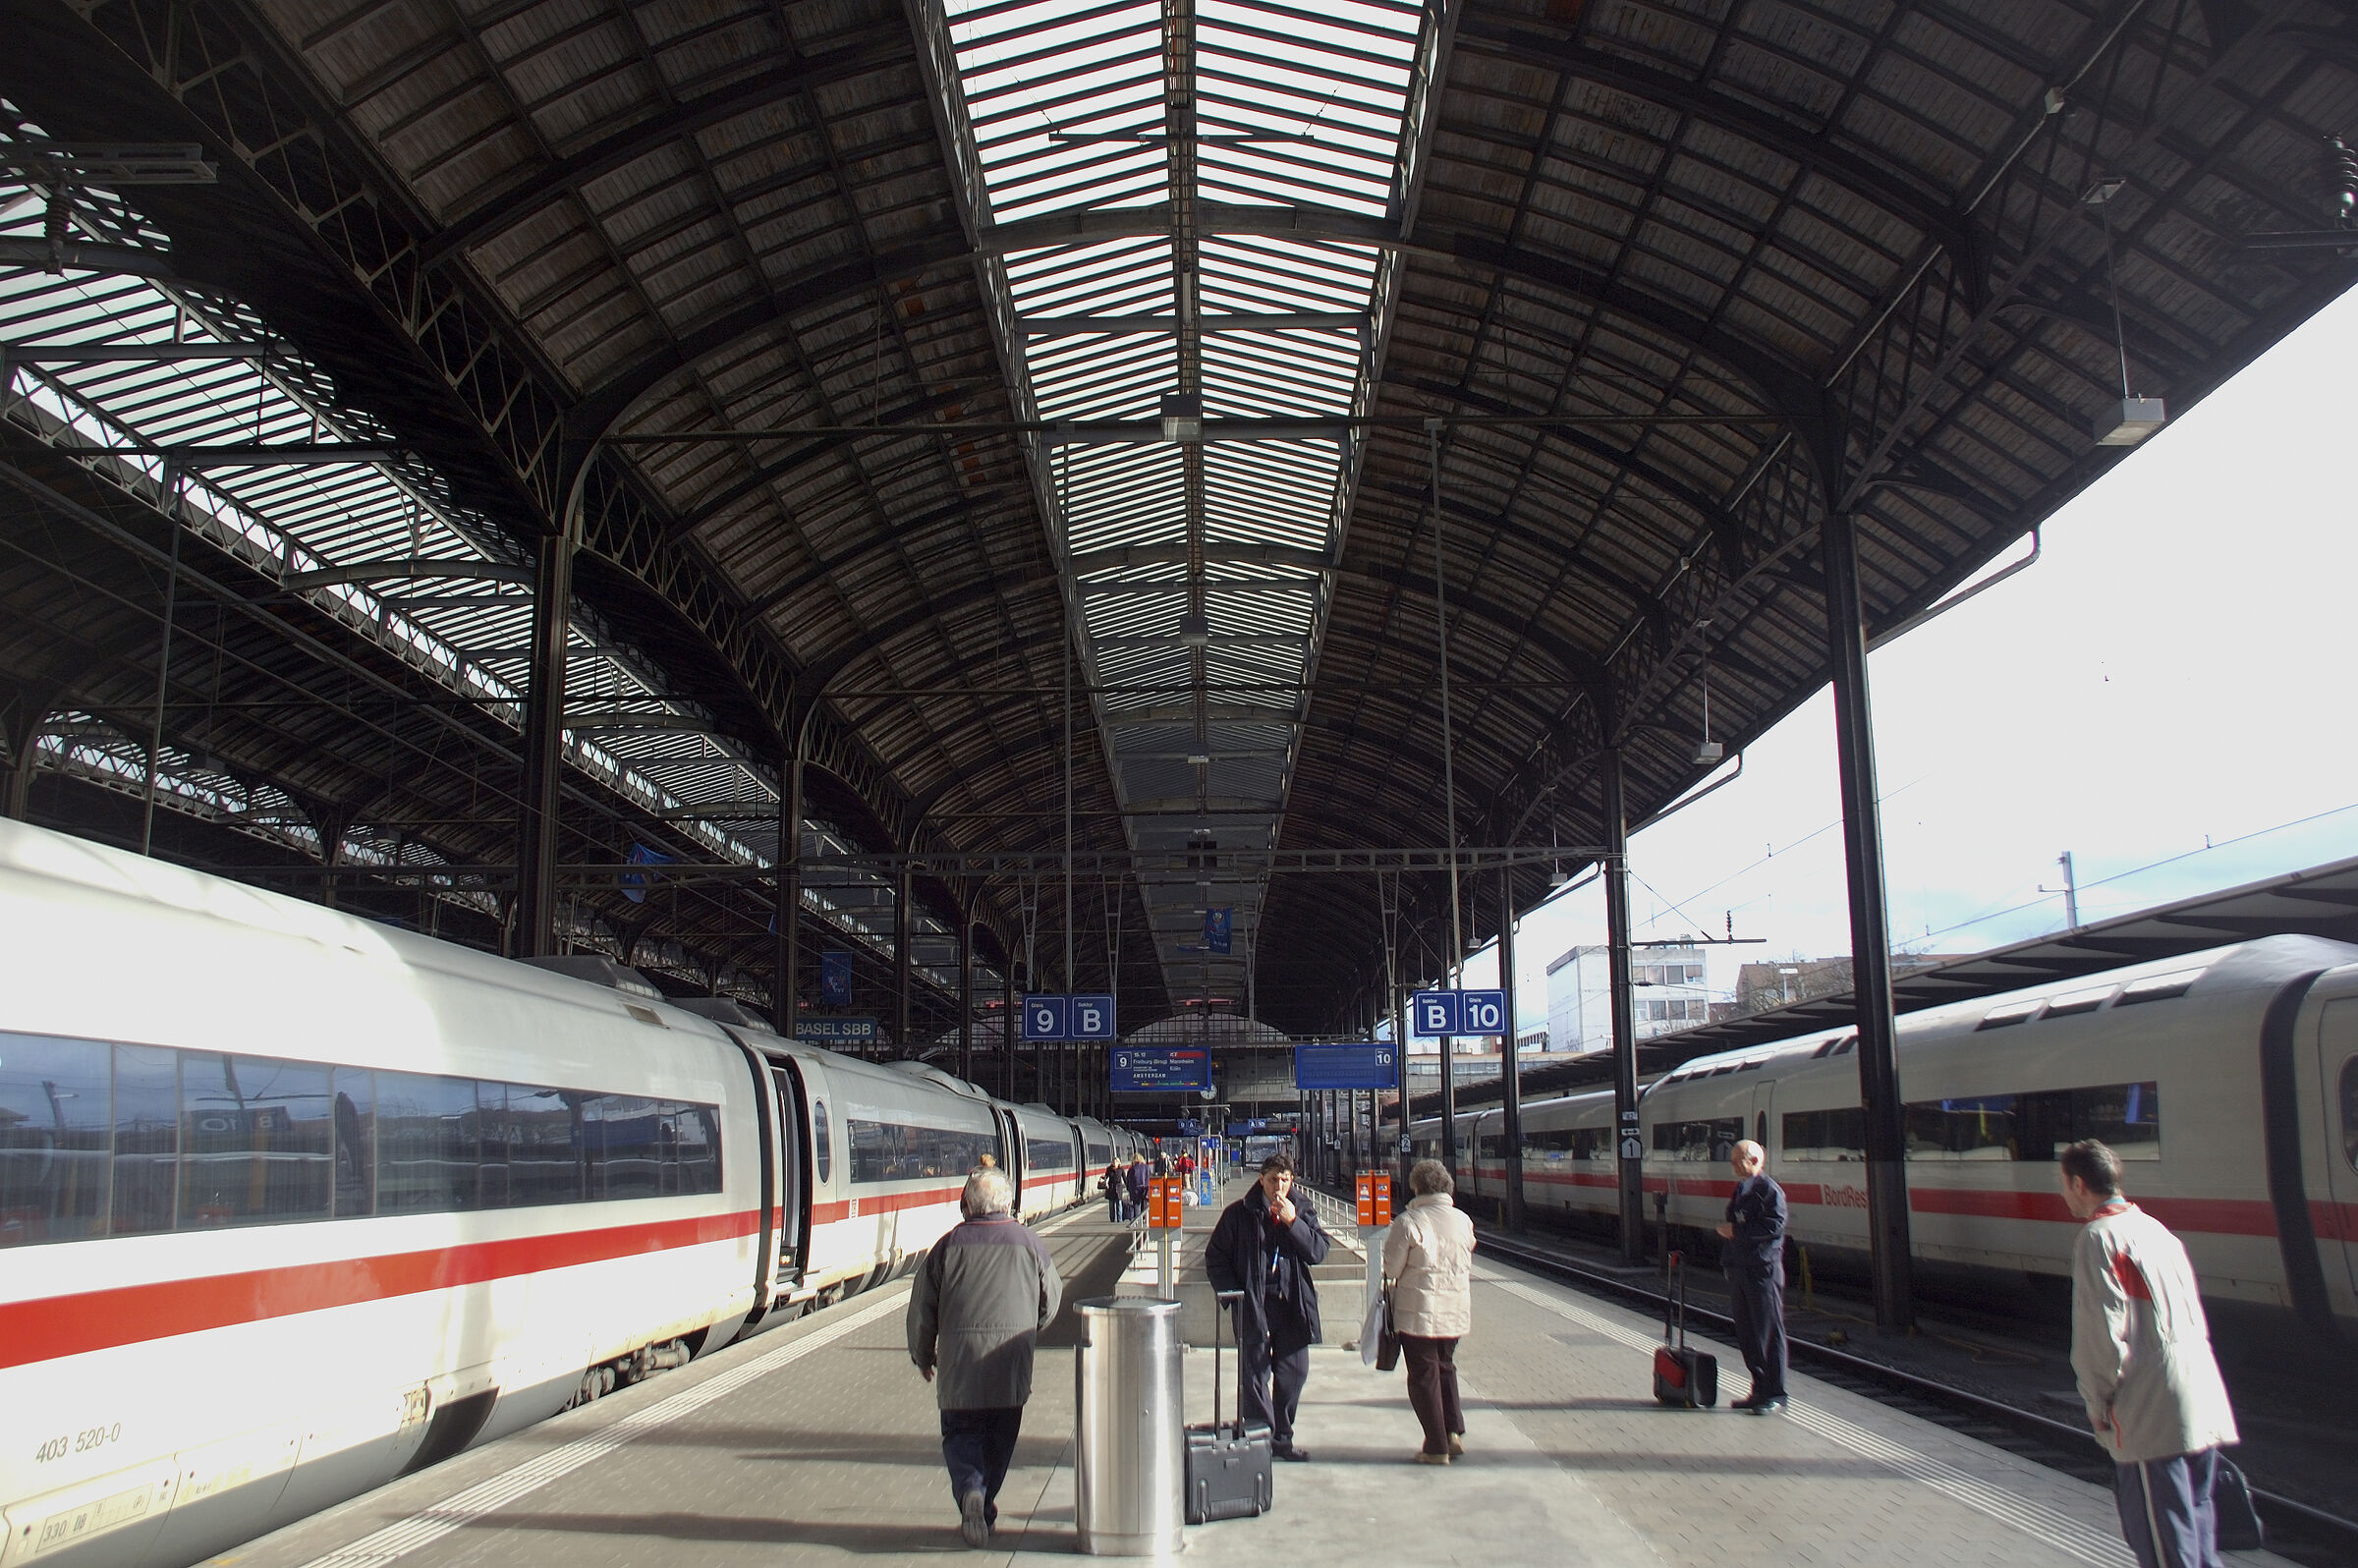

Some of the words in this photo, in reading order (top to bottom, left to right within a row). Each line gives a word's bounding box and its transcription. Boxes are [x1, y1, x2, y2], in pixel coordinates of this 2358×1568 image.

[1037, 1009, 1054, 1033] 9
[1083, 1009, 1101, 1033] B
[1428, 1005, 1447, 1029] B
[1469, 1004, 1499, 1028] 10
[796, 1023, 840, 1036] BASEL
[842, 1023, 871, 1036] SBB
[1119, 1056, 1128, 1068] 9
[1376, 1053, 1391, 1064] 10
[1628, 1141, 1634, 1157] 1
[1824, 1184, 1868, 1209] BordRes
[36, 1435, 68, 1463] 403
[76, 1422, 121, 1453] 520-0
